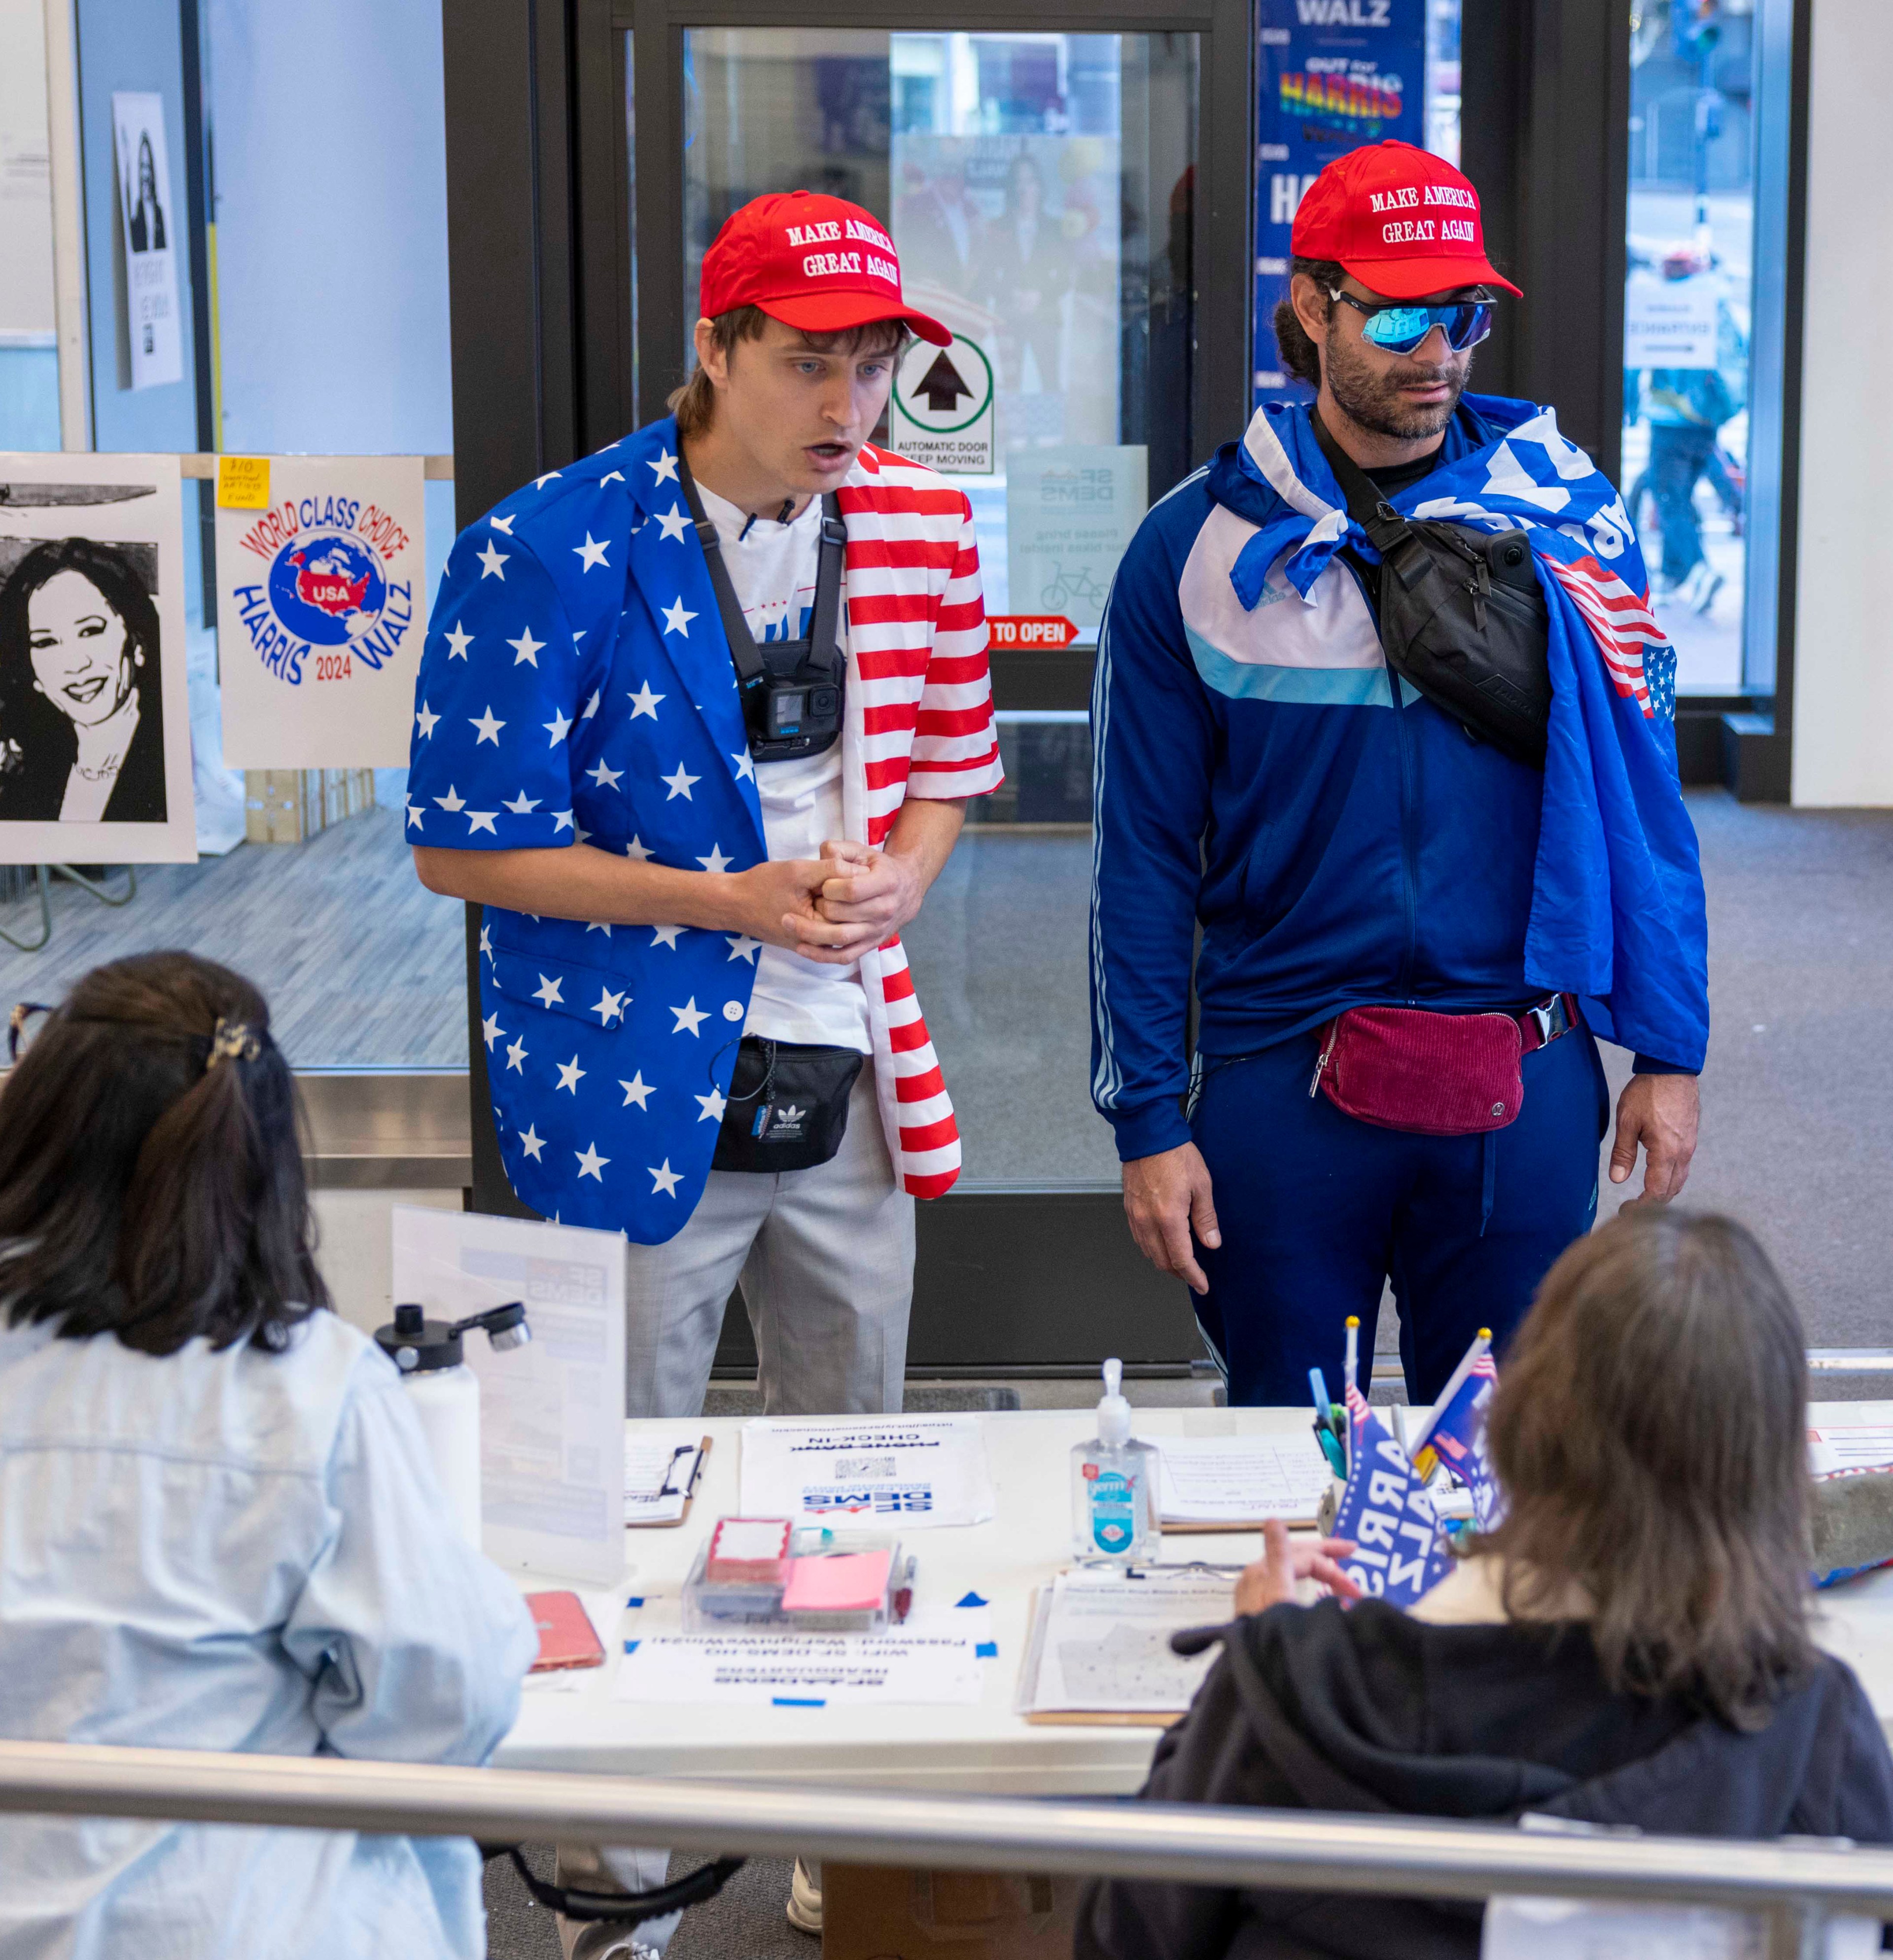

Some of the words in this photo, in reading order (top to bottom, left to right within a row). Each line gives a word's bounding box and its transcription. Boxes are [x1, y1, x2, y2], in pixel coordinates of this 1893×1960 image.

[1297, 0, 1391, 27] WALZ
[1280, 73, 1402, 118] HARRIS
[1370, 187, 1419, 212] MAKE
[1423, 186, 1476, 210] AMERICA
[786, 221, 841, 246] MAKE
[845, 219, 897, 257] AMERICA
[1382, 220, 1435, 244] GREAT
[1441, 220, 1474, 242] AGAIN
[803, 252, 861, 277] GREAT
[867, 254, 898, 286] AGAIN
[898, 442, 954, 451] AUTOMATIC
[958, 442, 988, 451] DOOR
[938, 455, 985, 465] MOVING
[240, 501, 299, 561] WORLD
[299, 495, 360, 529] CLASS
[358, 504, 410, 560] CHOICE
[313, 586, 350, 601] USA
[233, 585, 311, 686] HARRIS
[316, 655, 351, 680] 2024
[350, 580, 412, 671] WALZ
[994, 622, 1017, 642] TO
[1020, 622, 1066, 642] OPEN
[790, 1443, 853, 1452] BANK
[808, 1434, 920, 1443] CHECK-IN
[803, 1491, 933, 1505] DEMS
[875, 1501, 933, 1513] SF
